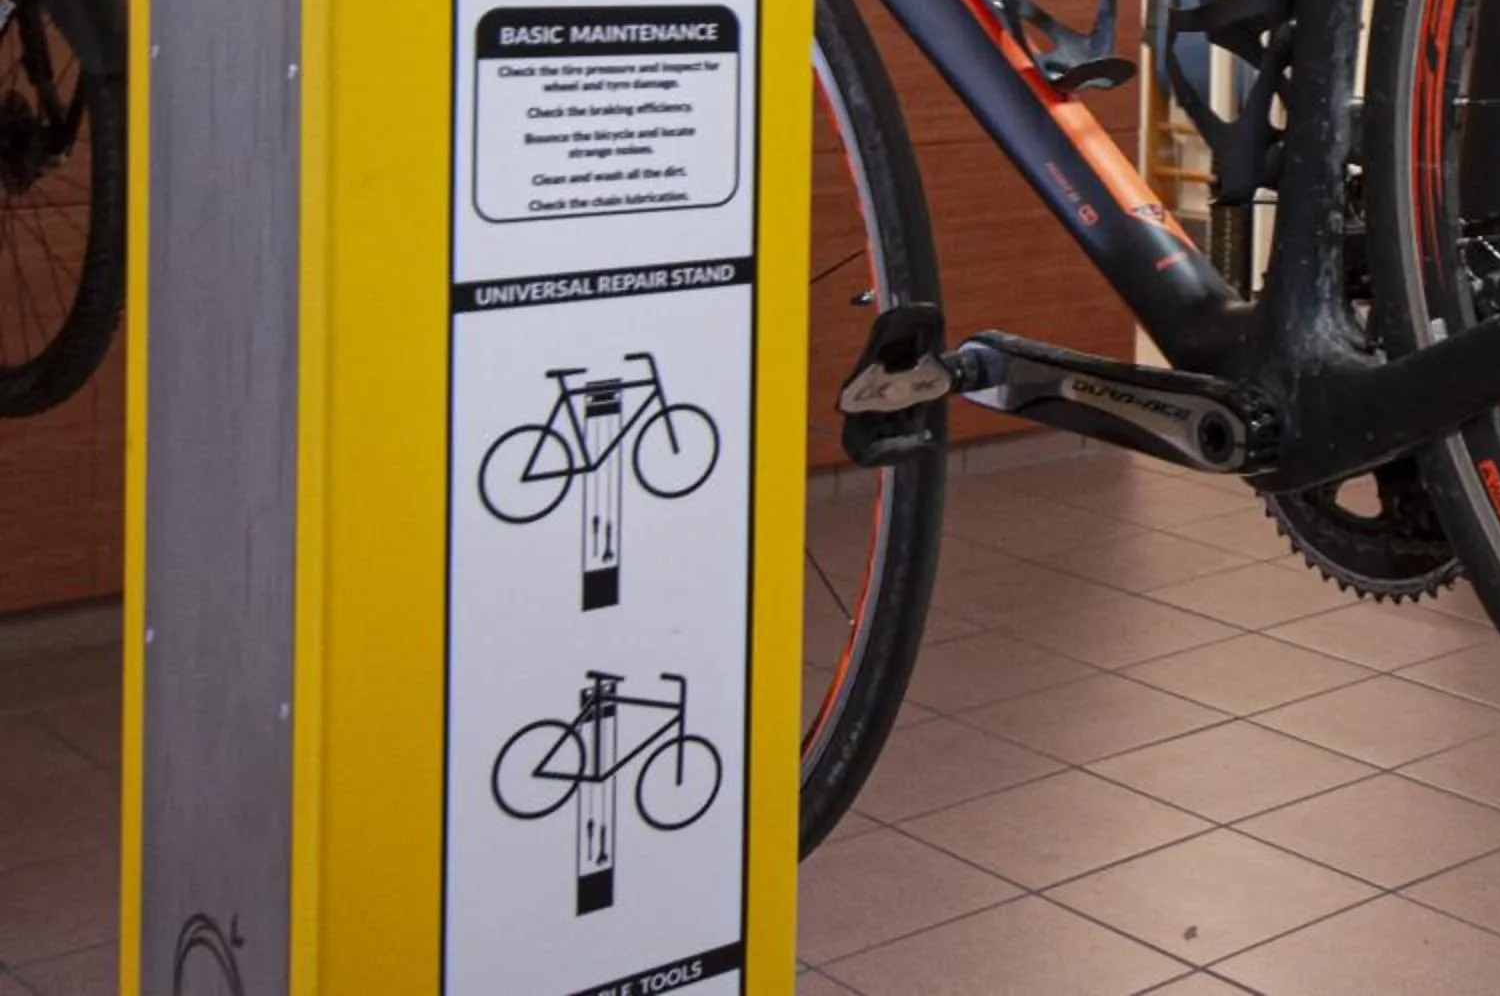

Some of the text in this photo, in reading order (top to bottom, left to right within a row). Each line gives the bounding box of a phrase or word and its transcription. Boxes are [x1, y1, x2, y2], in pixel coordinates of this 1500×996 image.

[500, 22, 719, 45] BASIC MAINTENANCE
[497, 65, 535, 78] Check
[538, 65, 558, 76] the
[638, 62, 659, 73] and
[543, 81, 579, 92] wheel
[581, 80, 602, 91] and
[527, 107, 564, 119] Check
[567, 106, 586, 116] the
[572, 130, 591, 141] the
[637, 127, 659, 138] and
[531, 173, 567, 186] Clean
[569, 172, 592, 183] and
[626, 168, 640, 180] all
[642, 167, 662, 178] the
[528, 199, 566, 212] Check
[569, 197, 588, 209] the
[591, 195, 622, 207] chain
[474, 263, 736, 306] UNIVERSAL REPAIR STAND
[639, 960, 703, 996] TOOLS
